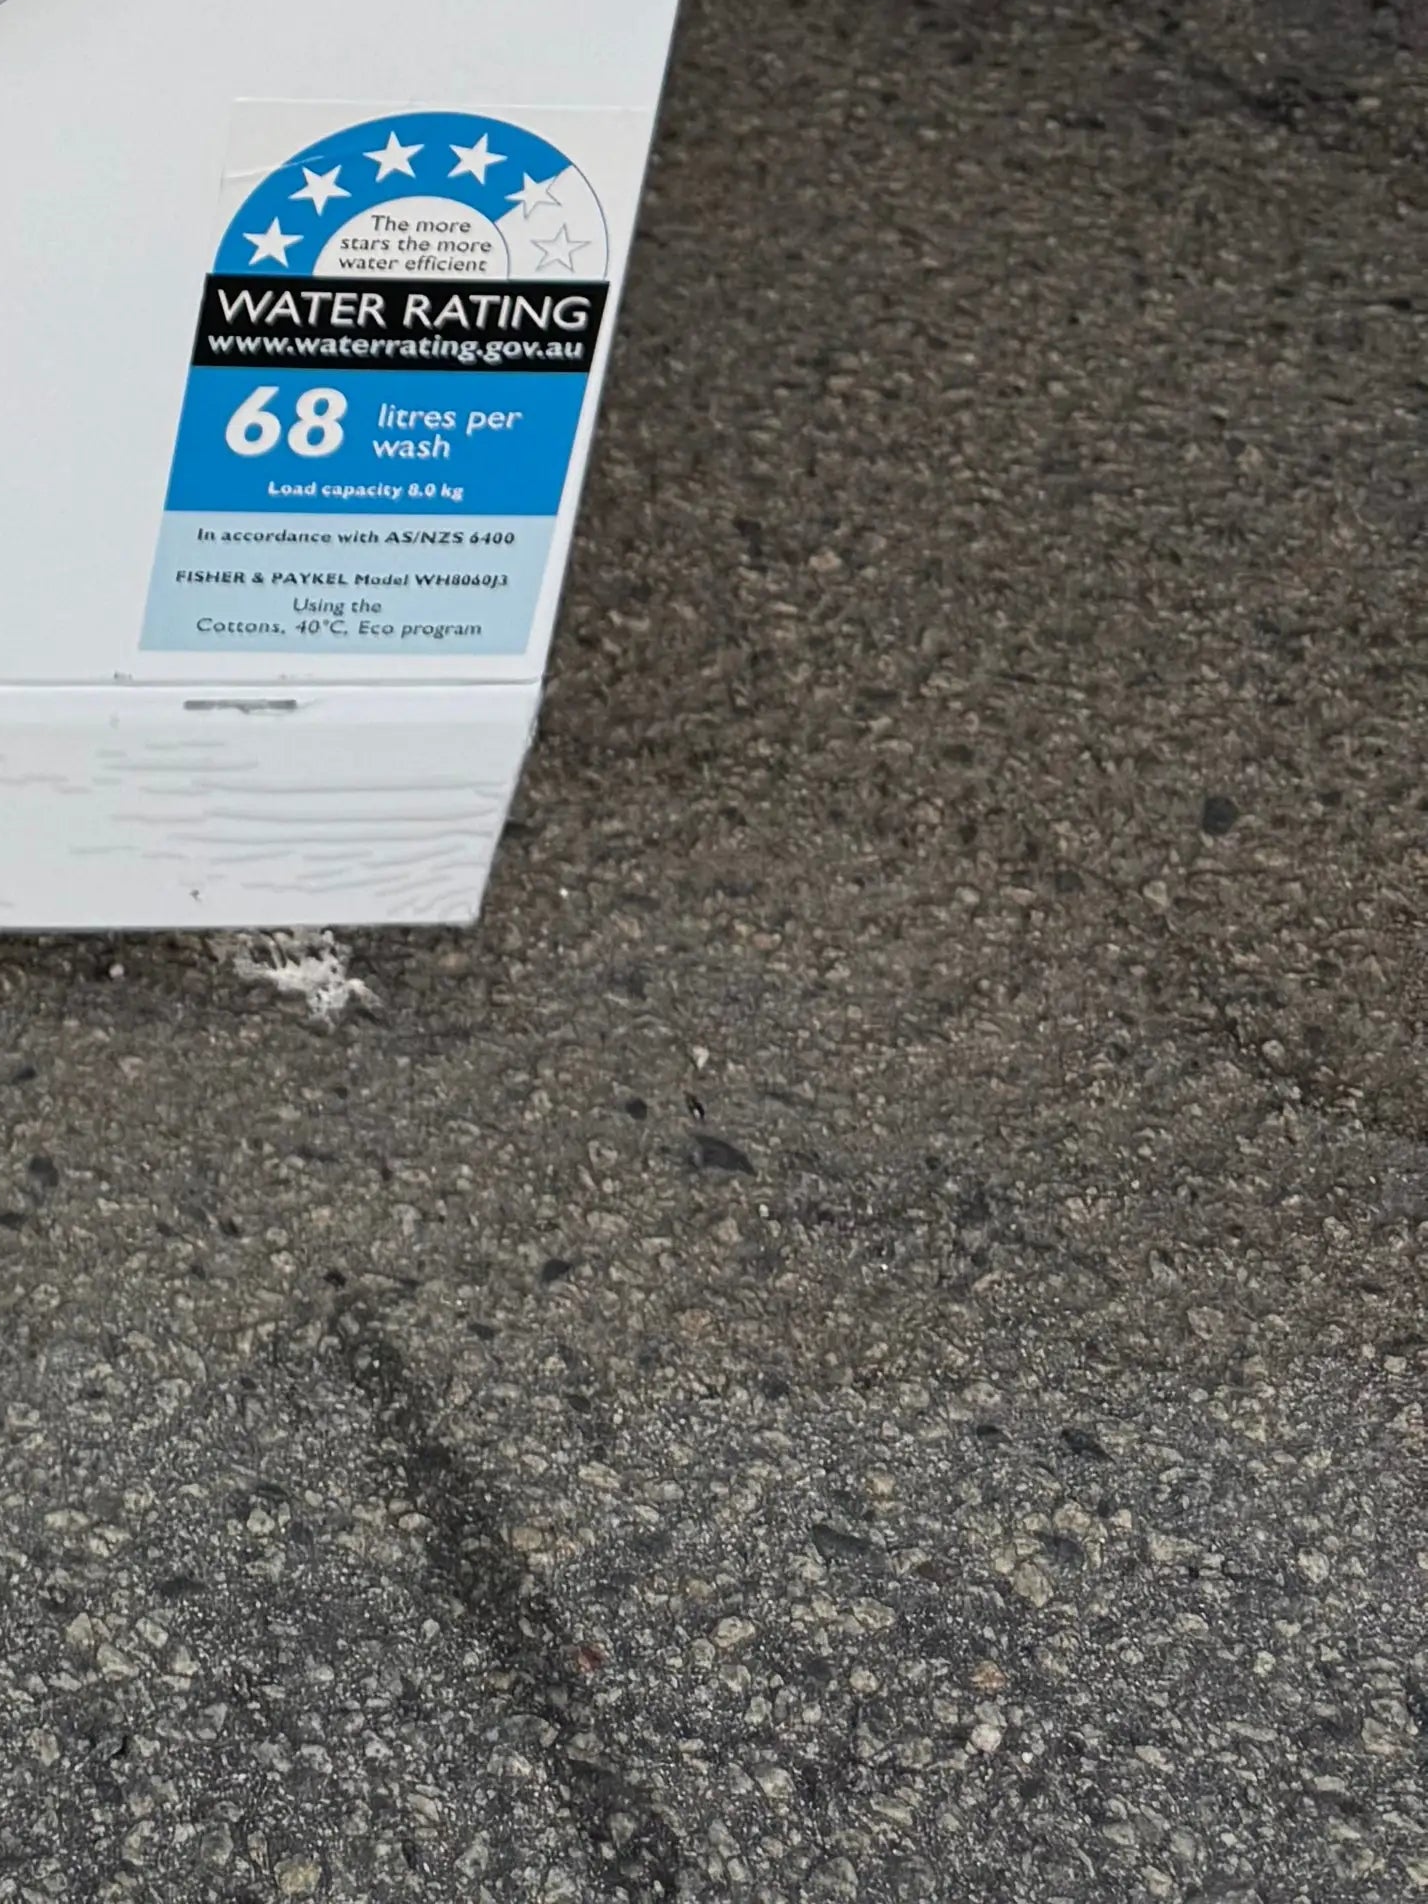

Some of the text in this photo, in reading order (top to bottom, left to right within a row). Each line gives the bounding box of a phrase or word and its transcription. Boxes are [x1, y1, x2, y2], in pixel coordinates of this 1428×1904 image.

[372, 215, 471, 233] The more
[341, 236, 491, 253] stars the more
[339, 255, 486, 271] water efficient
[218, 289, 590, 330] WATER RATING
[208, 335, 582, 363] www.waterrating.gov.au
[225, 386, 347, 457] 68
[379, 404, 522, 435] litres per
[372, 435, 450, 458] wash
[268, 482, 463, 501] Load capacity 8.0 kg
[198, 528, 514, 544] In accordance with AS/NZS 6400
[176, 571, 244, 583] FISHER
[252, 573, 263, 583] &
[272, 573, 347, 584] PAYKEL
[355, 574, 408, 585] Model
[294, 598, 381, 616] Using the
[359, 621, 394, 635] Eco
[401, 625, 481, 639] program
